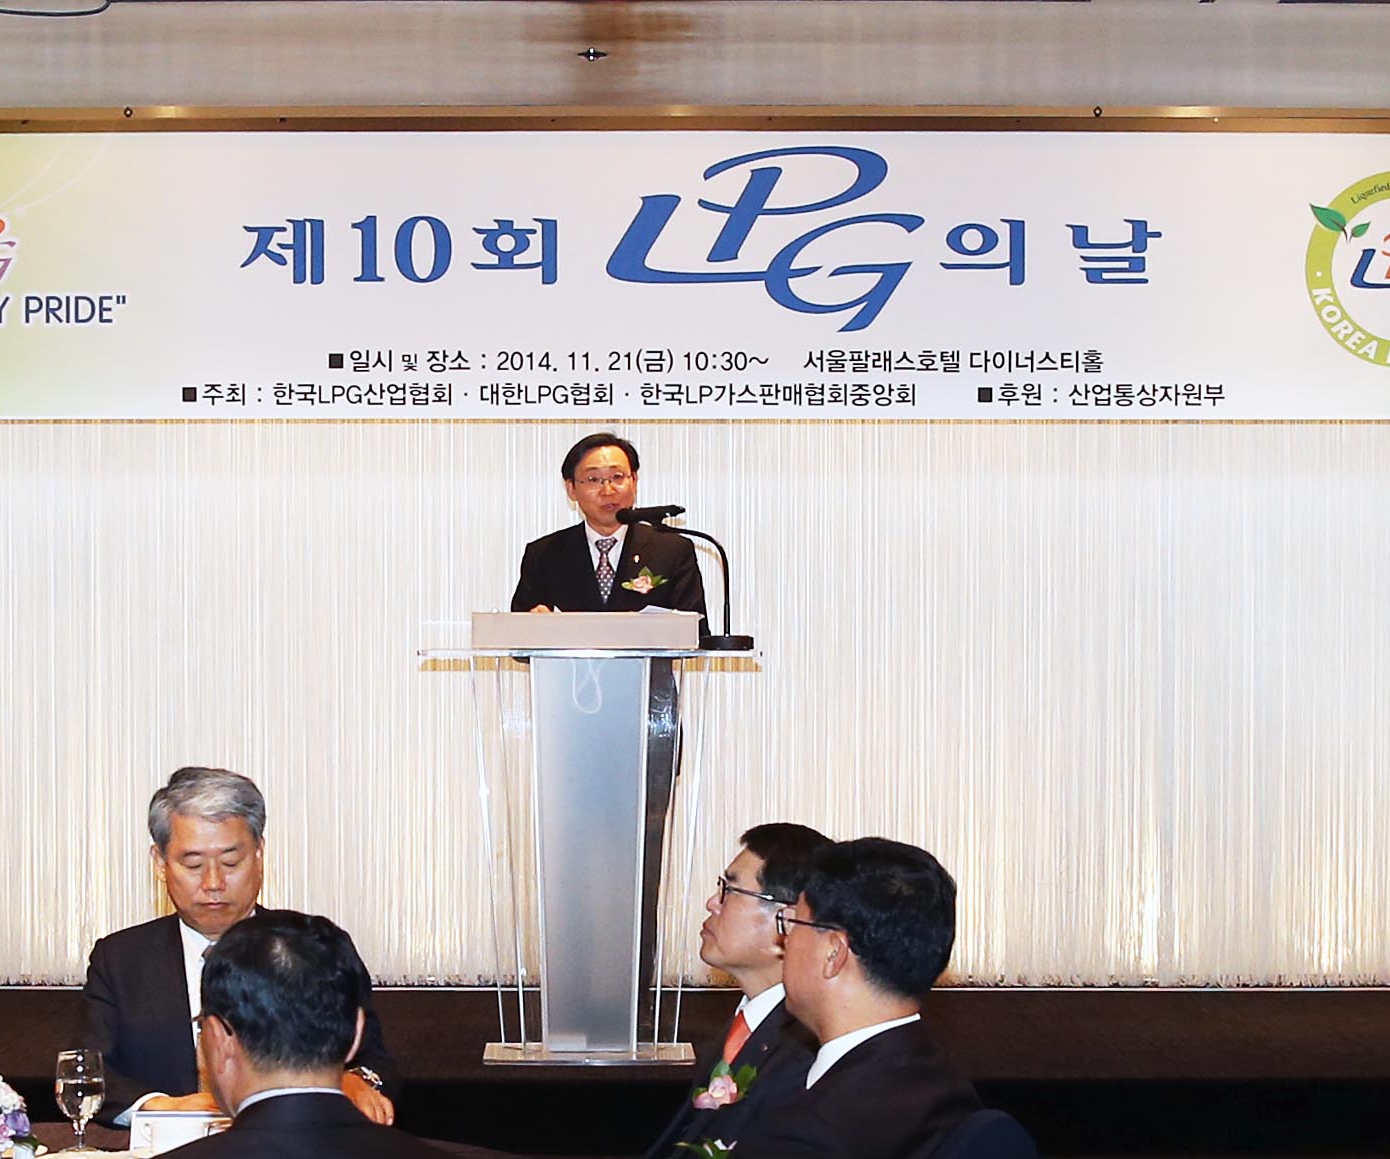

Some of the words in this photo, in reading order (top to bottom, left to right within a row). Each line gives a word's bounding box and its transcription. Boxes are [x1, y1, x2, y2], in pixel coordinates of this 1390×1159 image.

[1349, 182, 1390, 205] Liquefied
[1067, 218, 1162, 286] 날
[1311, 286, 1380, 361] KOREA
[400, 353, 419, 373] 및
[426, 349, 472, 374] 장소
[495, 350, 559, 372] 2014.
[567, 350, 600, 372] 11.
[607, 348, 675, 374] 21(금)
[802, 349, 961, 374] 서울팔래스호텔
[968, 349, 1105, 374] 다이너스티홀
[271, 382, 453, 407] 한국LPG산업협회
[479, 382, 614, 407] 대한LPG협회
[639, 382, 917, 408] 한국LP가스판매협회중앙회
[1067, 382, 1227, 408] 산업통상자원부
